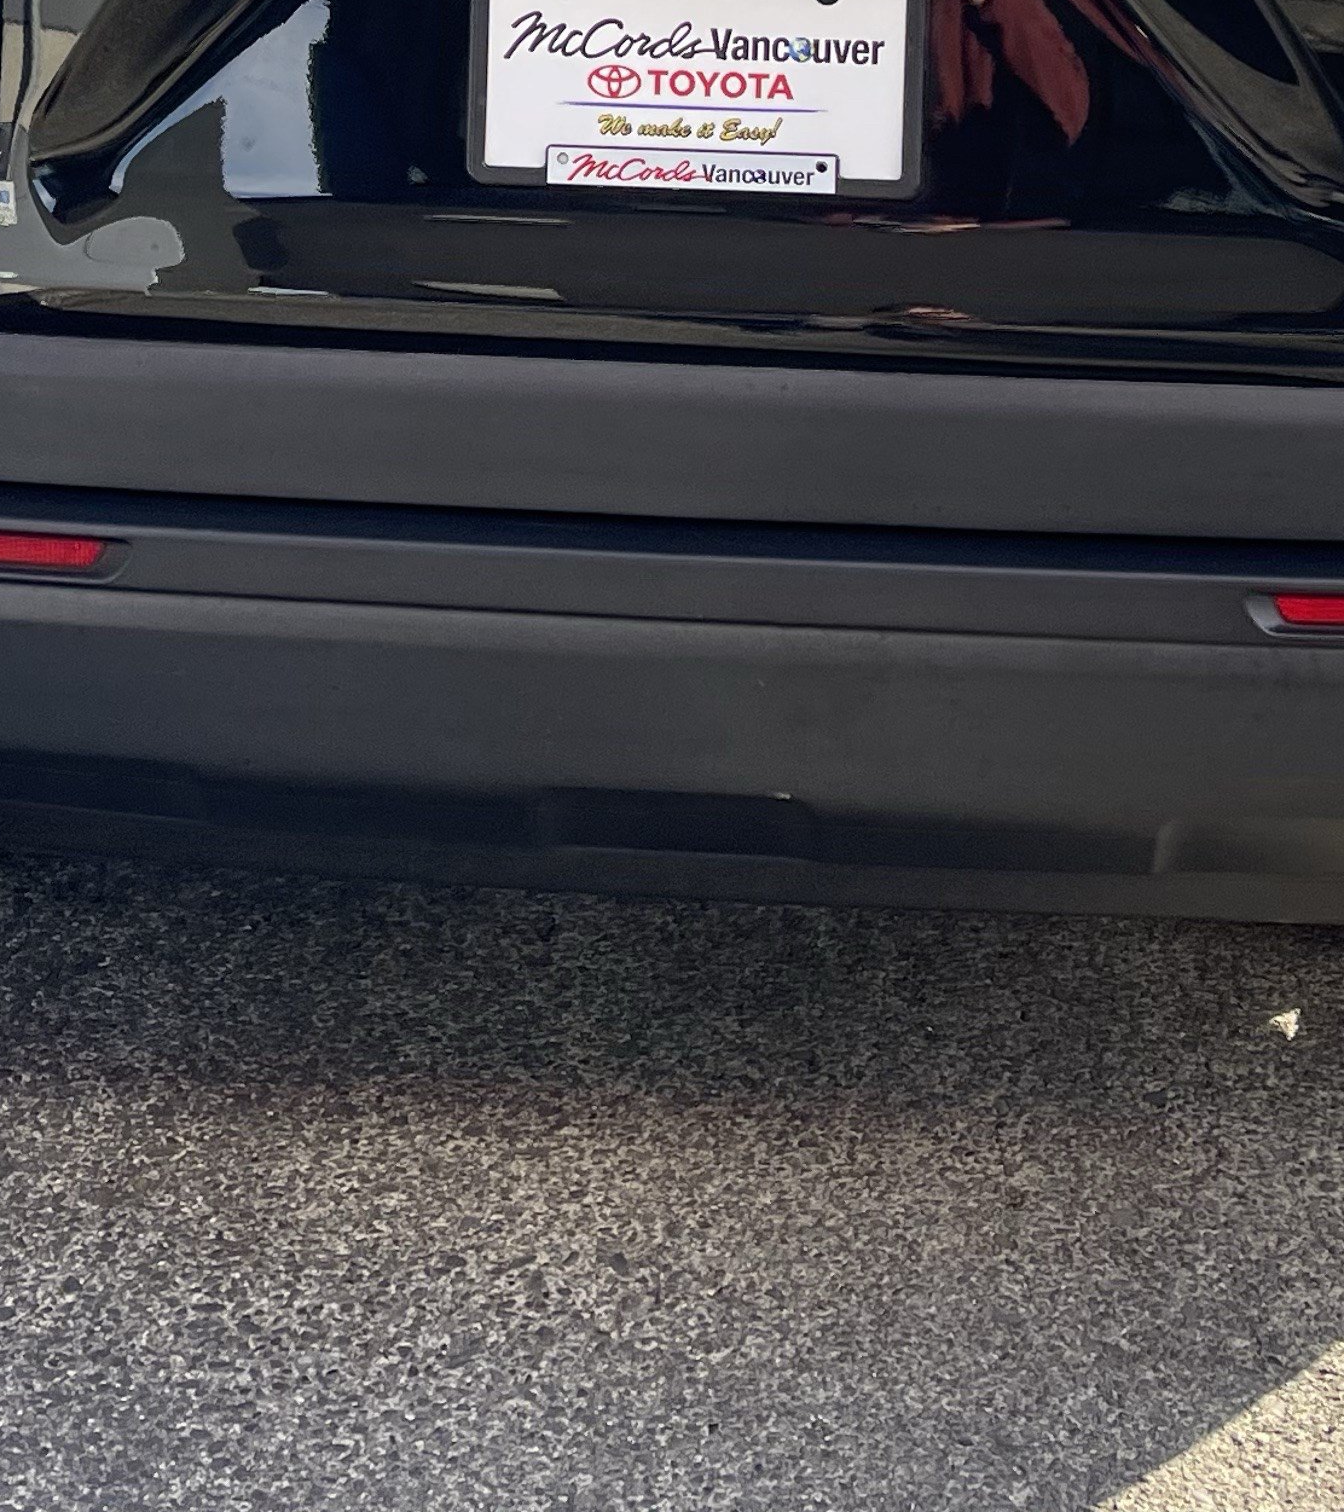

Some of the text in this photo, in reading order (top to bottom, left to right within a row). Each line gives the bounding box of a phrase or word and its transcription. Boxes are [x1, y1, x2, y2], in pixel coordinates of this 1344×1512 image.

[647, 69, 794, 101] TOYOTA
[597, 113, 783, 146] We make it Easy!
